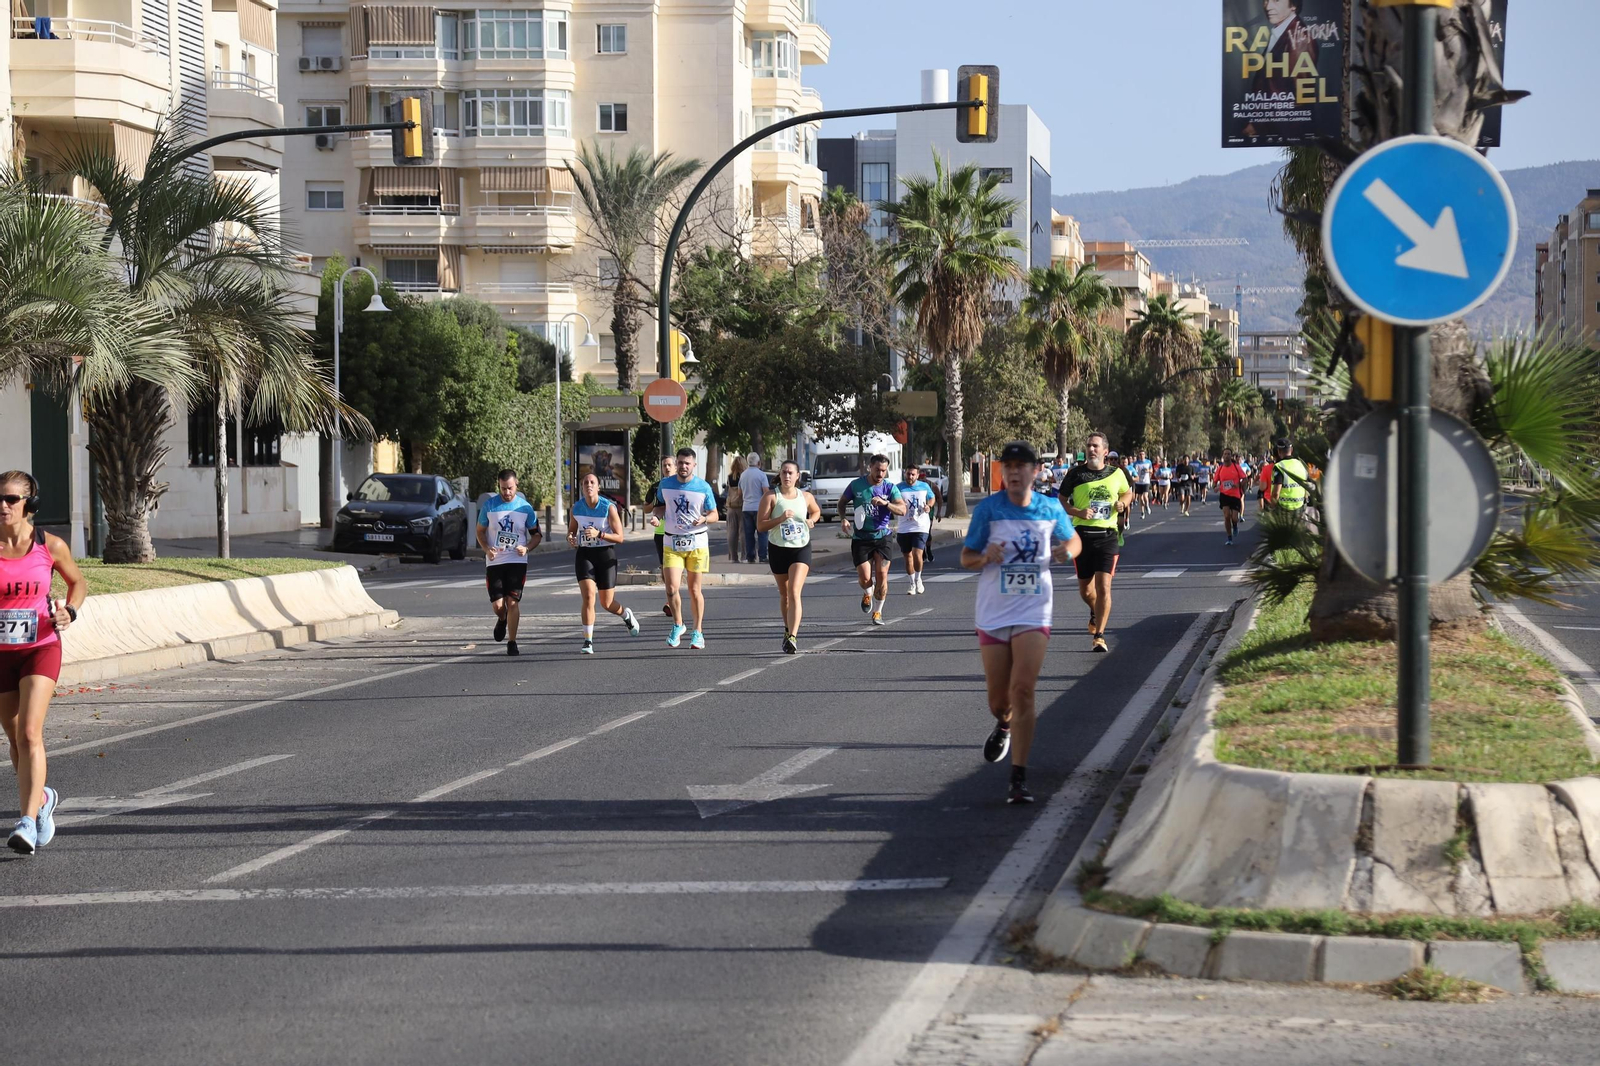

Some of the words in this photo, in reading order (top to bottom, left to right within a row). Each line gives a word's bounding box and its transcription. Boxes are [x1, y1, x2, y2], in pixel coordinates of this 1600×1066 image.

[1225, 25, 1271, 53] RA
[1241, 51, 1319, 79] PHA
[1244, 90, 1296, 102] MÁLAGA
[1296, 77, 1339, 104] EL
[1232, 103, 1240, 111] 2
[1241, 102, 1294, 110] NOVIEMBRE
[605, 479, 620, 490] KING
[784, 526, 802, 536] 33
[499, 536, 516, 545] 637
[675, 539, 692, 547] 457
[1006, 573, 1036, 585] 731
